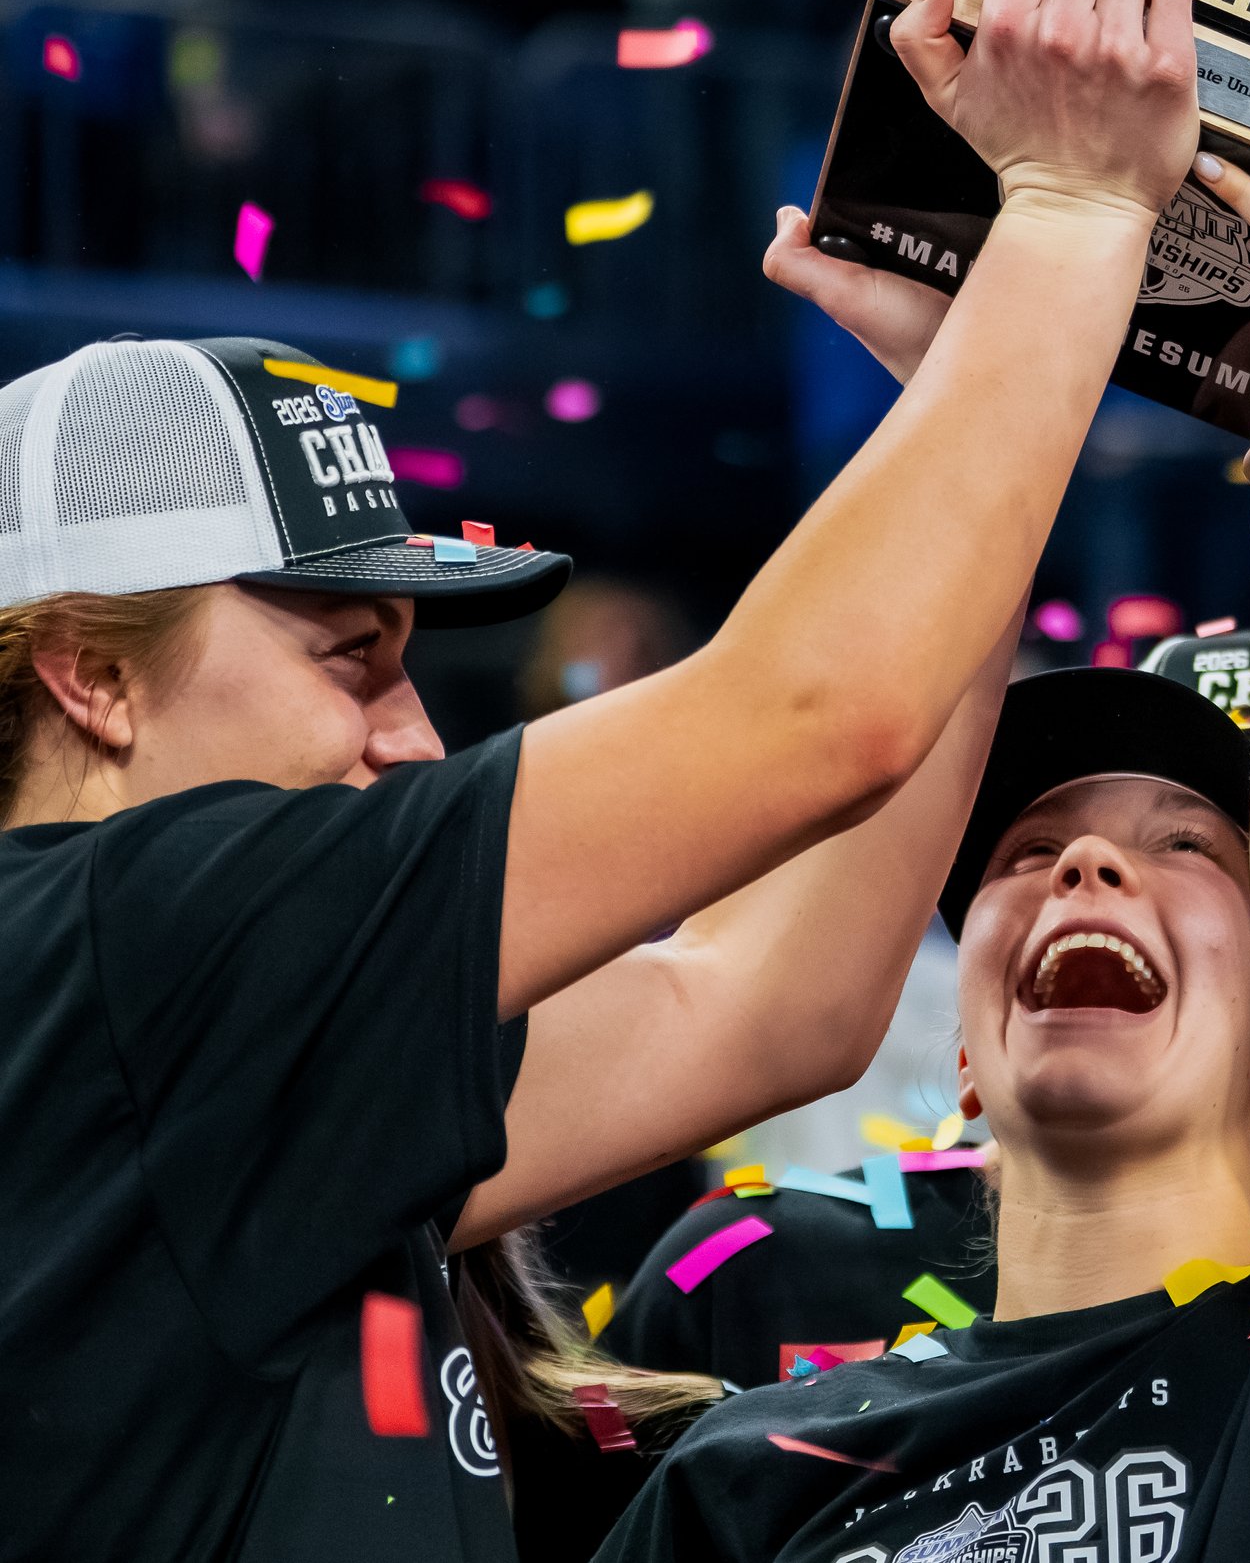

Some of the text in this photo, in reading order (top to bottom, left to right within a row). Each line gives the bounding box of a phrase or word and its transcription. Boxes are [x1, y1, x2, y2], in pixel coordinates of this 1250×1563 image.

[1197, 66, 1223, 85] ate
[870, 222, 974, 278] #MA
[1150, 236, 1245, 295] NSHIPS
[272, 394, 323, 426] 2026
